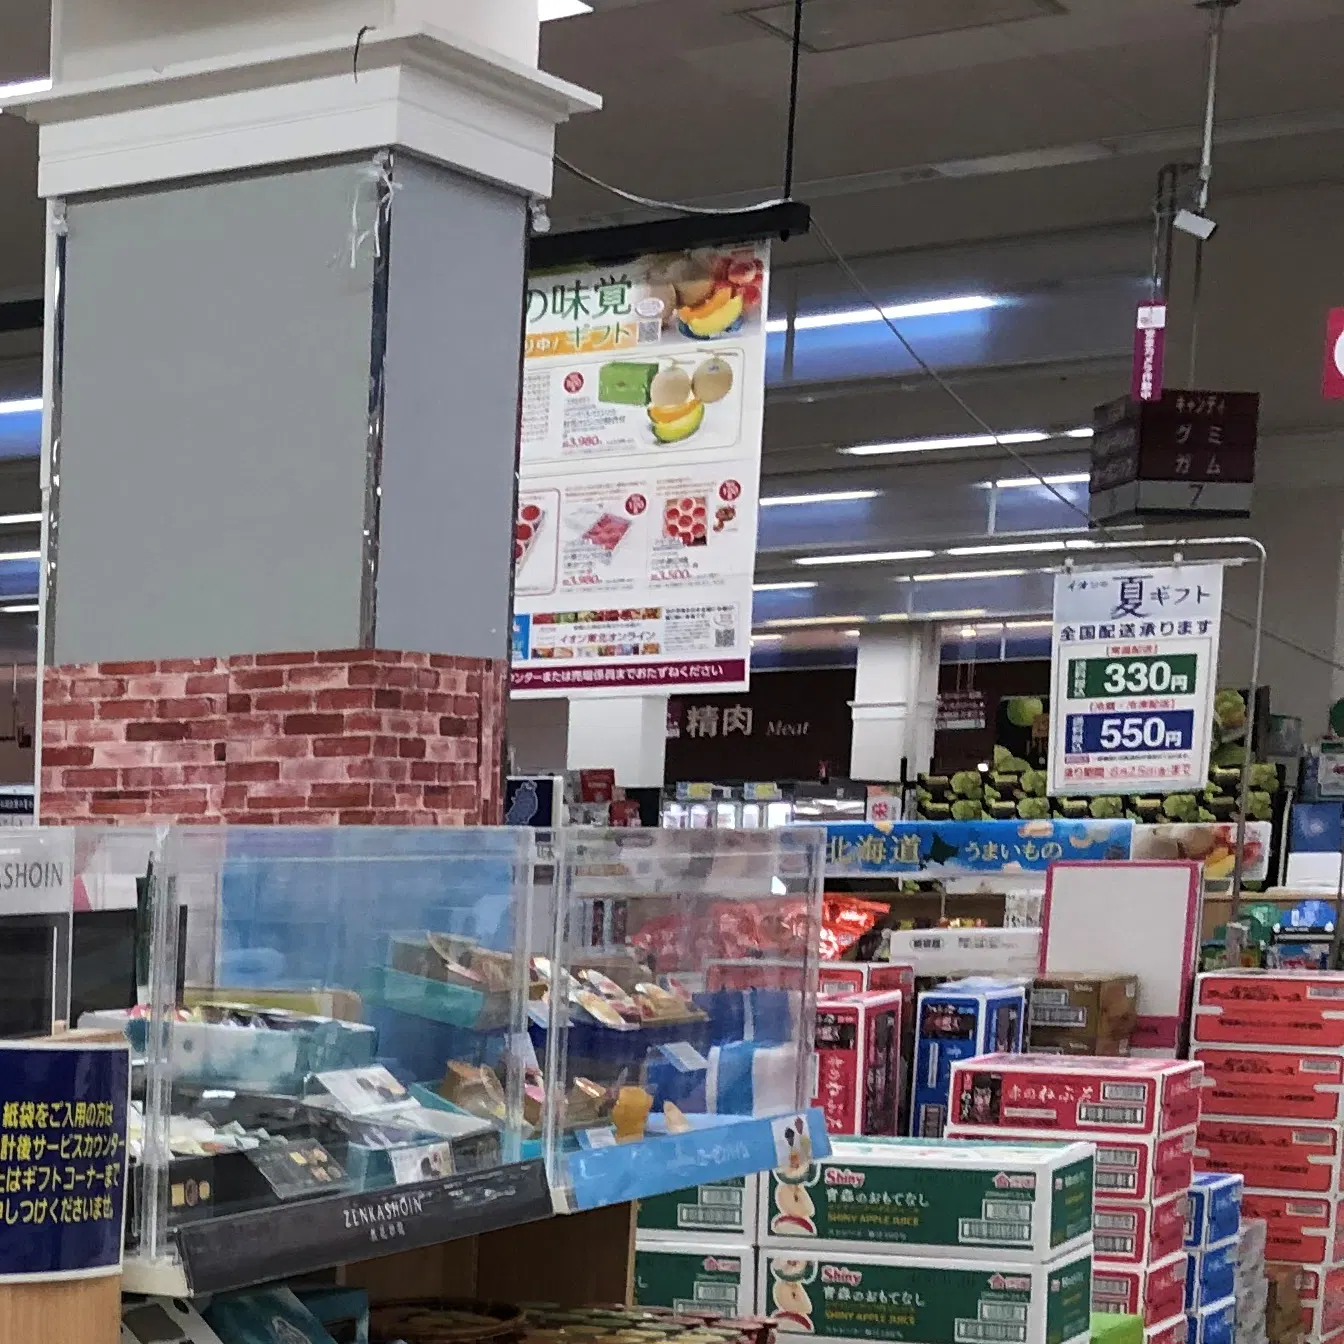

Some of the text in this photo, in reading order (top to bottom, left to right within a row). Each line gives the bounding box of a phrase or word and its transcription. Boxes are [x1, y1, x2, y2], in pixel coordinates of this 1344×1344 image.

[1189, 485, 1204, 506] 7
[1112, 574, 1211, 619] 夏ギフト
[1060, 619, 1212, 642] 全国配送承ります
[1103, 660, 1189, 693] 330円
[686, 704, 753, 738] 精肉
[765, 720, 811, 737] Meat
[1100, 716, 1182, 750] 550円
[827, 834, 922, 865] 北海道
[964, 841, 1062, 862] うまいもの
[2, 1101, 115, 1129] 紙袋をご入用の方は
[825, 1168, 864, 1185] Shiny
[826, 1188, 930, 1208] 青森のおもてなし
[343, 1196, 424, 1229] ZENKASHOIN
[822, 1267, 861, 1285] Shiny
[823, 1286, 925, 1307] 青森のおもてなし
